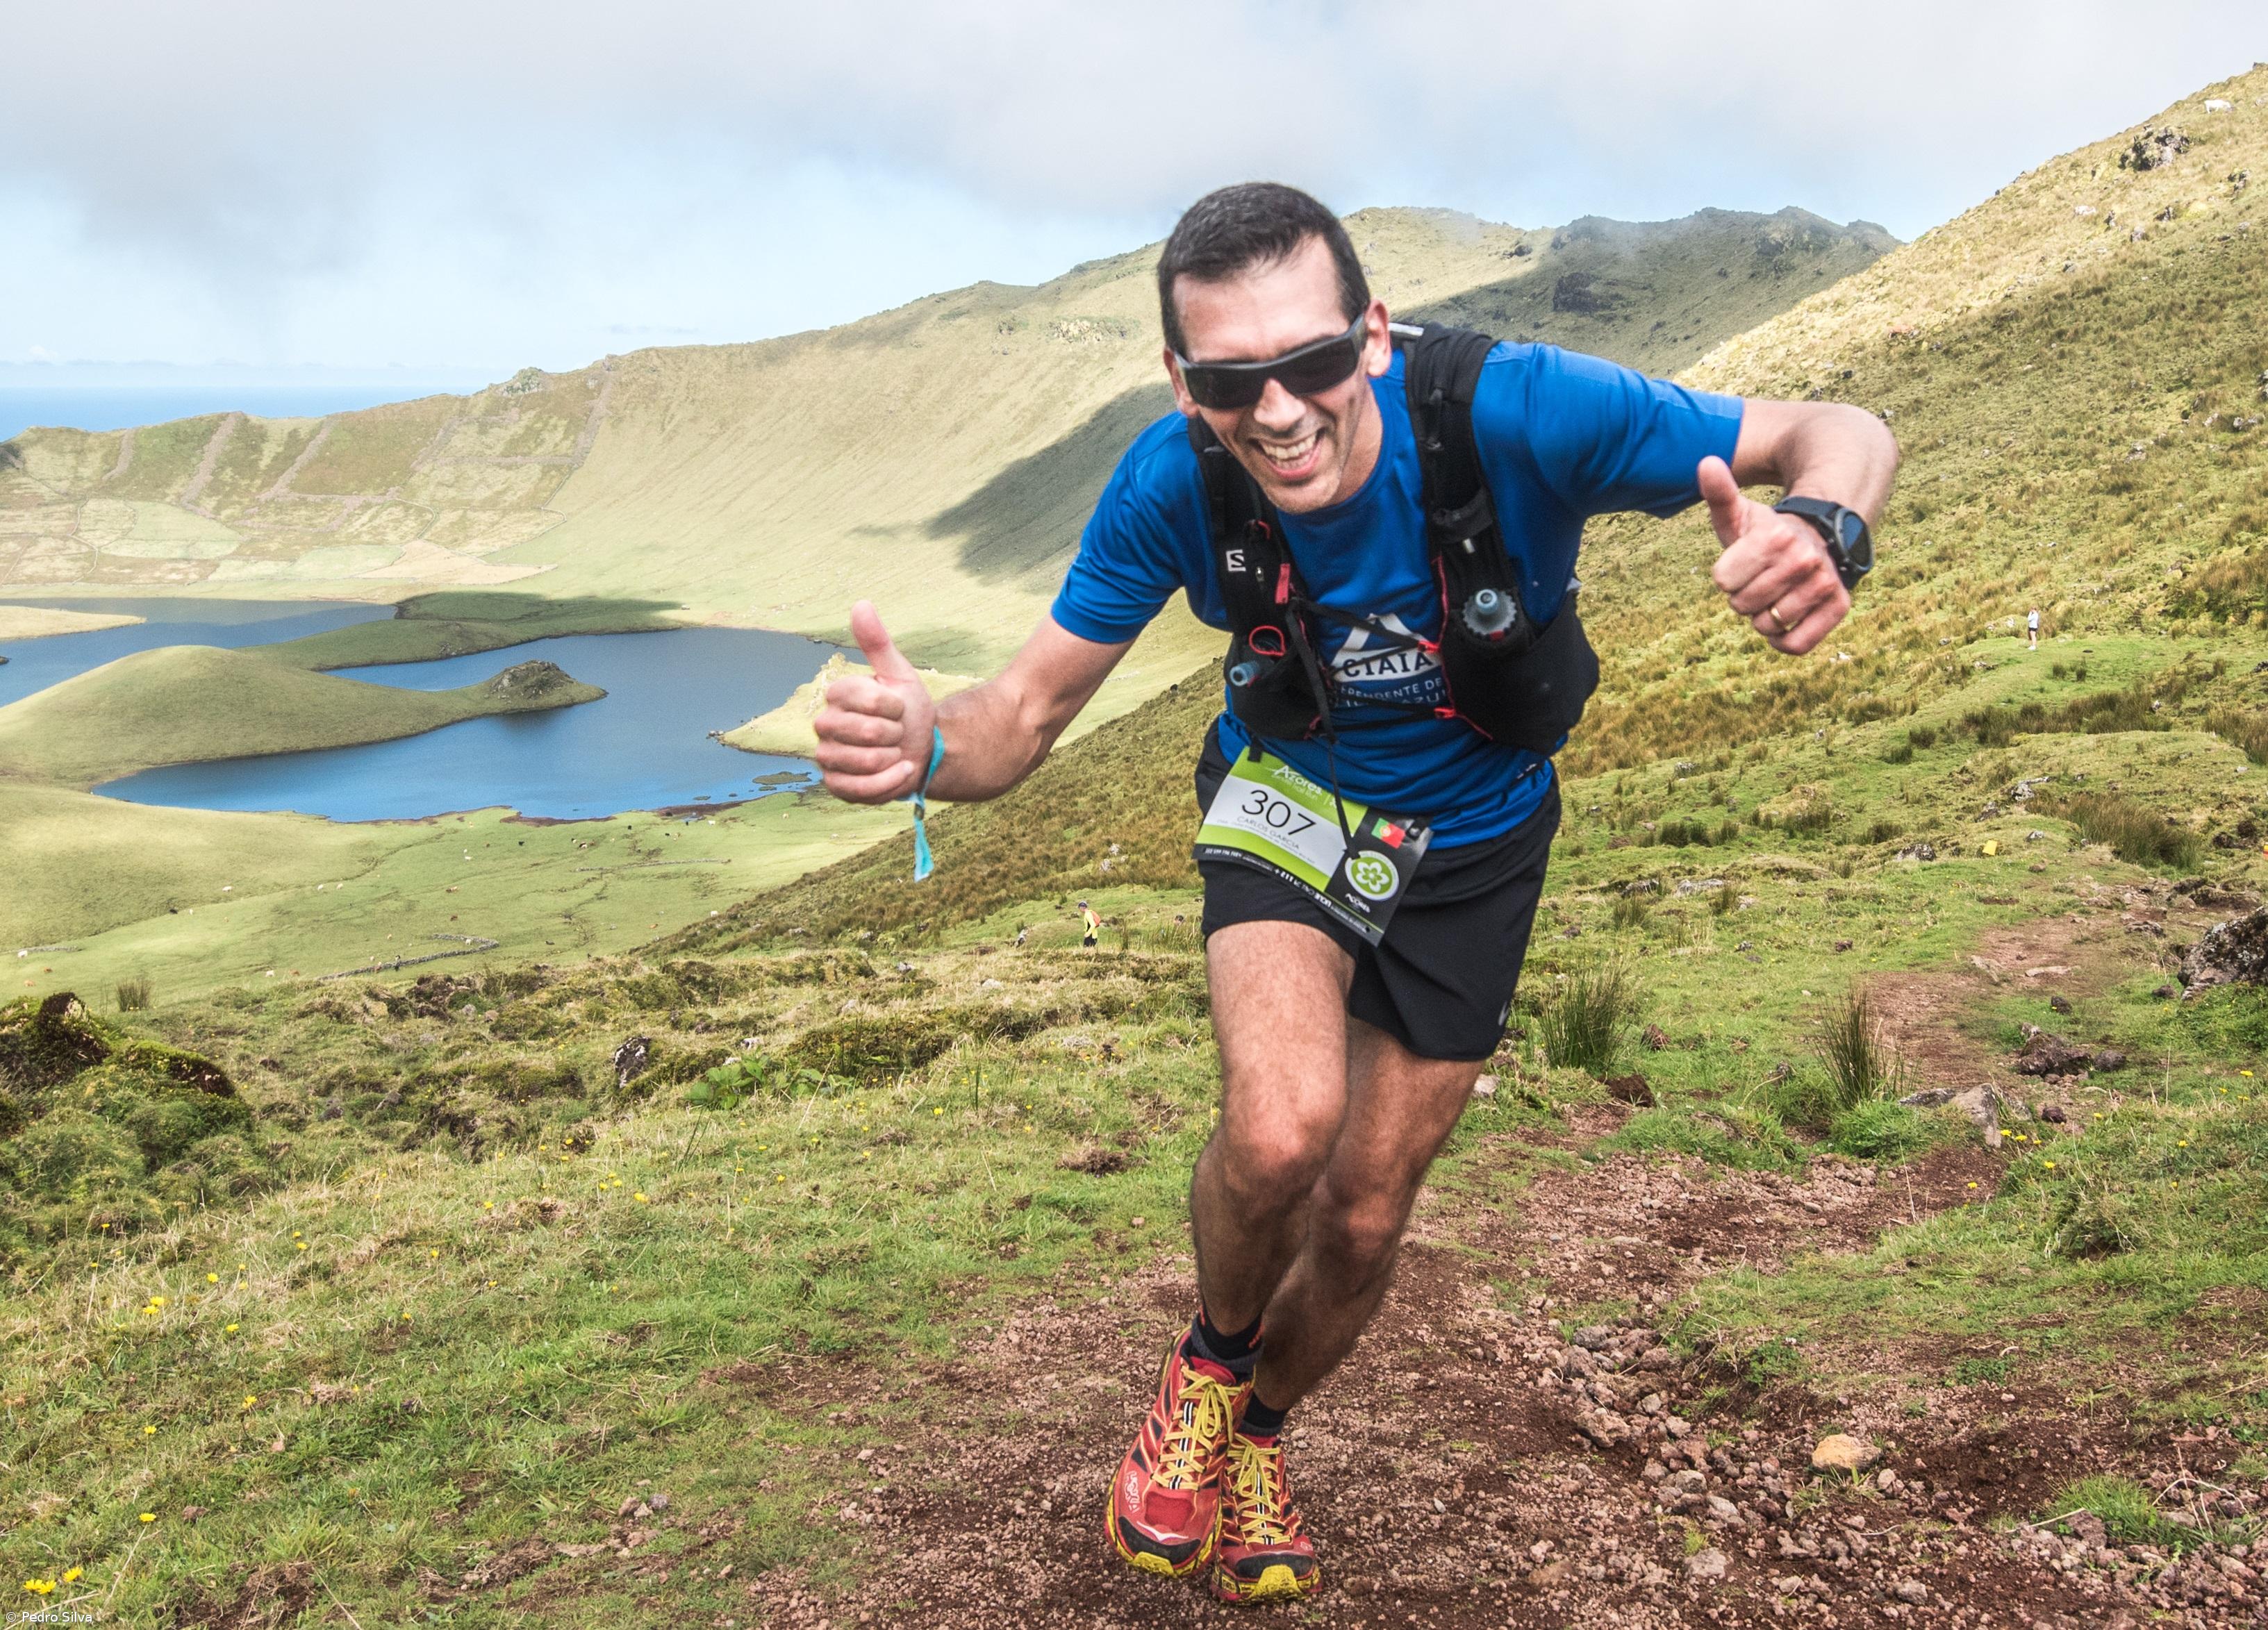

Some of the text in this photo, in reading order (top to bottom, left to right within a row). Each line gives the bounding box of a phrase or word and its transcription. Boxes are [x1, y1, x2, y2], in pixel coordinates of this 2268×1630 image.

[1273, 765, 1322, 795] Azores
[1241, 789, 1316, 836] 307
[1236, 815, 1268, 832] CARLOS
[1269, 829, 1300, 849] GARCIA
